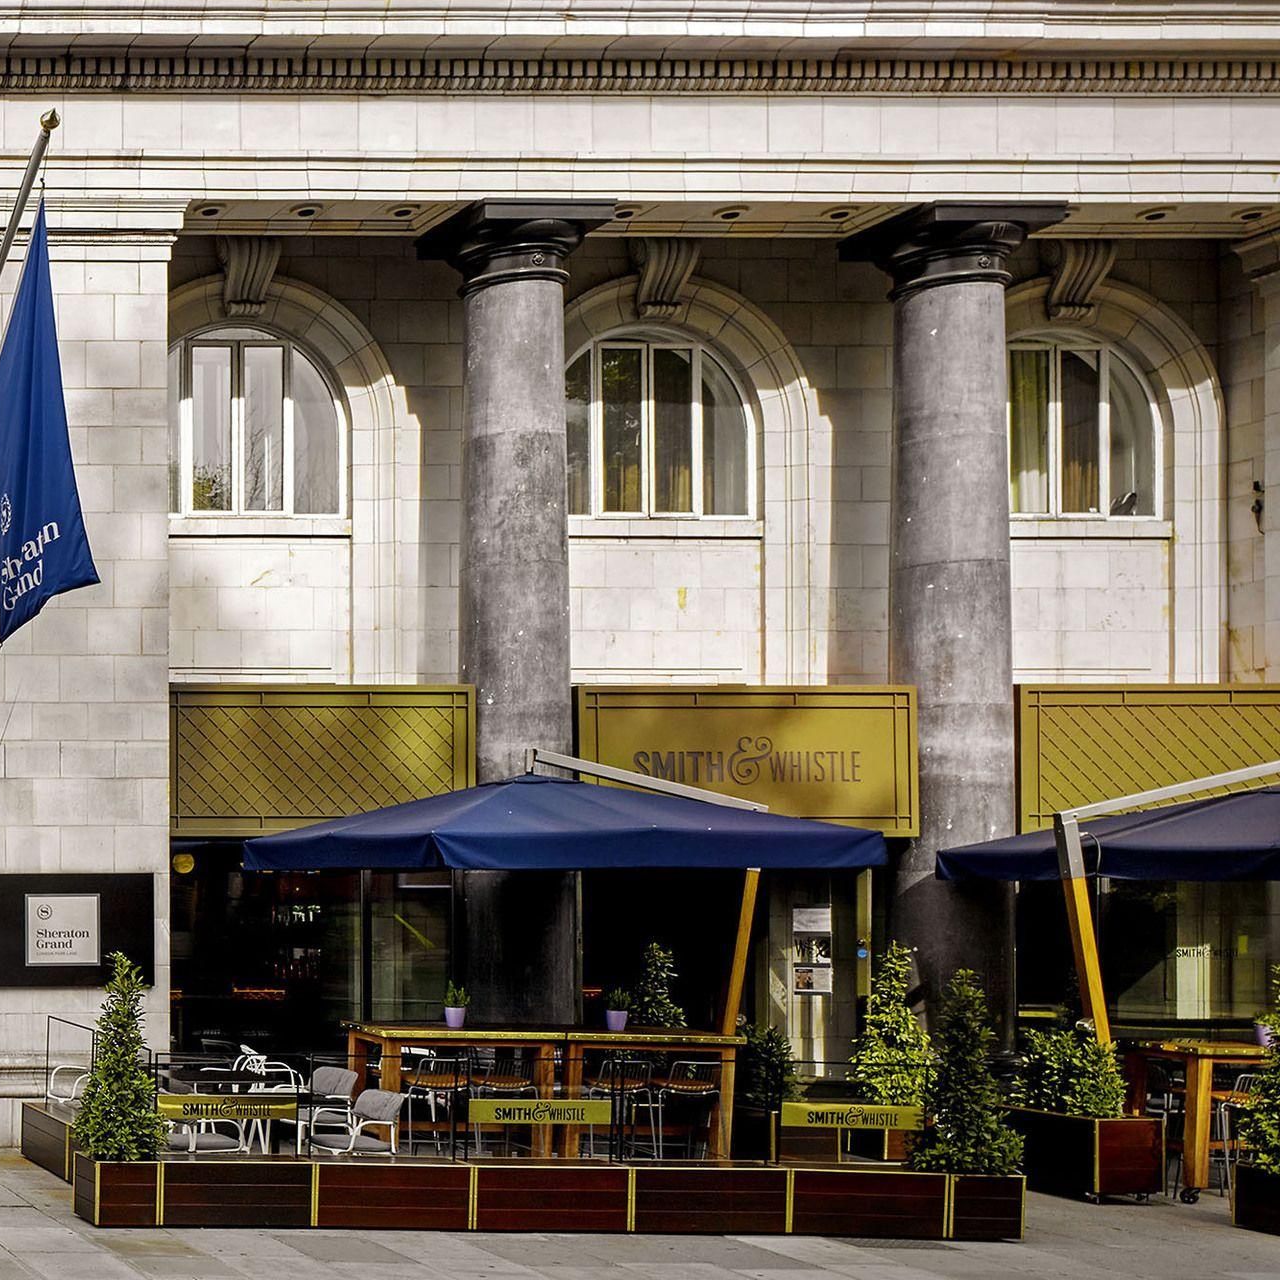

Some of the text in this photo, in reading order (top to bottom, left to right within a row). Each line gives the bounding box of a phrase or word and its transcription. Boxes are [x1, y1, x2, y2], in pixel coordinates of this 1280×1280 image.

[633, 751, 724, 783] SMITH
[769, 751, 863, 783] WHISTLE
[36, 928, 90, 938] Sheraton
[36, 939, 73, 949] Grand
[182, 1102, 219, 1116] SMITH
[236, 1103, 271, 1117] WHISTLE
[495, 1107, 531, 1120] SMITH
[549, 1107, 585, 1121] WHISTLE
[807, 1111, 844, 1125] SMITH
[861, 1113, 898, 1127] WHISTLE
